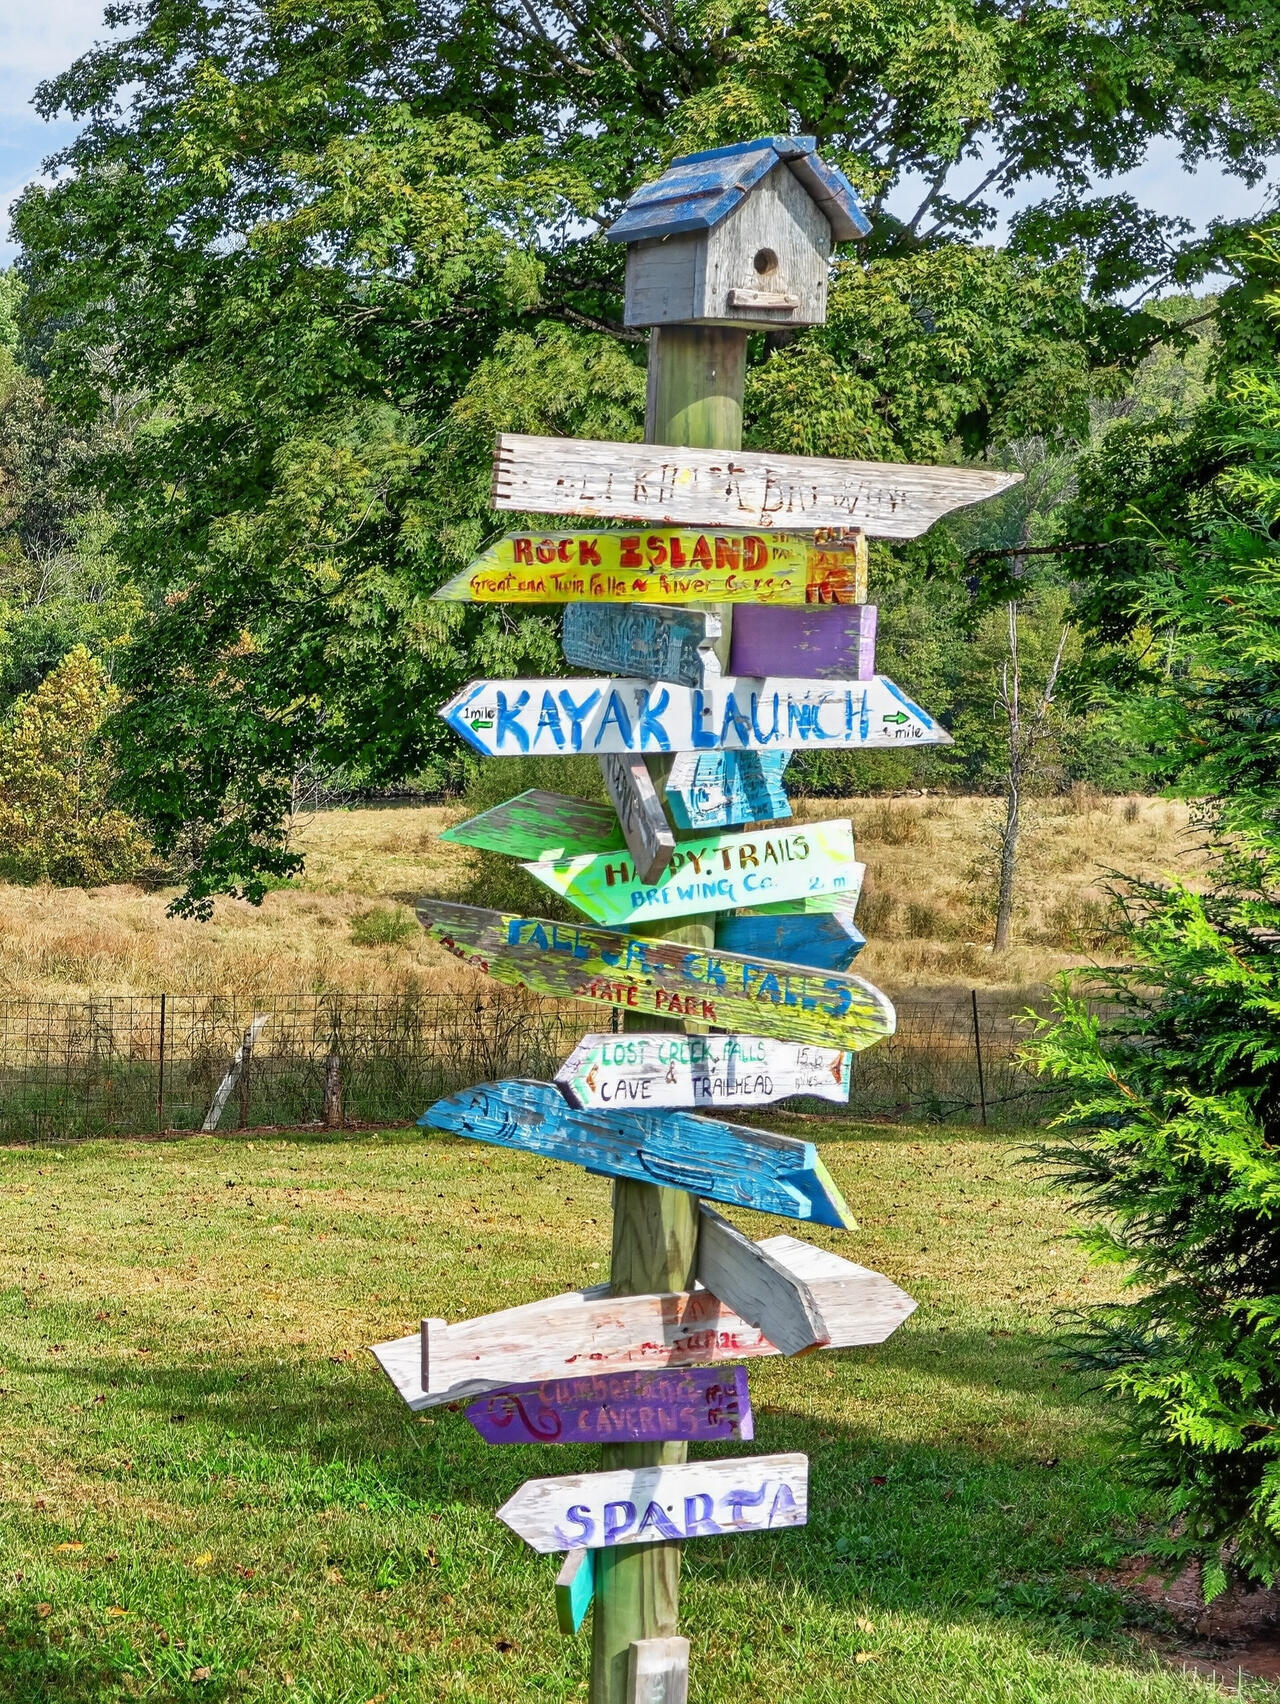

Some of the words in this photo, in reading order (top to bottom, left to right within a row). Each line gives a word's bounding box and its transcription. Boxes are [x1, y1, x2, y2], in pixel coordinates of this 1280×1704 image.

[513, 537, 602, 567] ROCK
[620, 534, 769, 572] ISLAND
[469, 572, 517, 596] Great
[659, 575, 710, 595] River
[495, 688, 671, 753] KAYAK
[690, 688, 872, 747] LAUNCH
[895, 724, 925, 738] mile
[713, 834, 810, 871] TRAILS
[630, 876, 737, 908] BREWING
[655, 988, 718, 1023] PARK
[741, 964, 853, 1018] FALLS
[601, 1040, 650, 1066] LOST
[658, 1040, 715, 1065] CREEK
[722, 1040, 767, 1063] FALLS
[601, 1079, 654, 1101] CAVE
[691, 1074, 774, 1098] TRAILHEAD
[576, 1405, 700, 1434] CAVERNS
[553, 1480, 798, 1548] SPARTA
